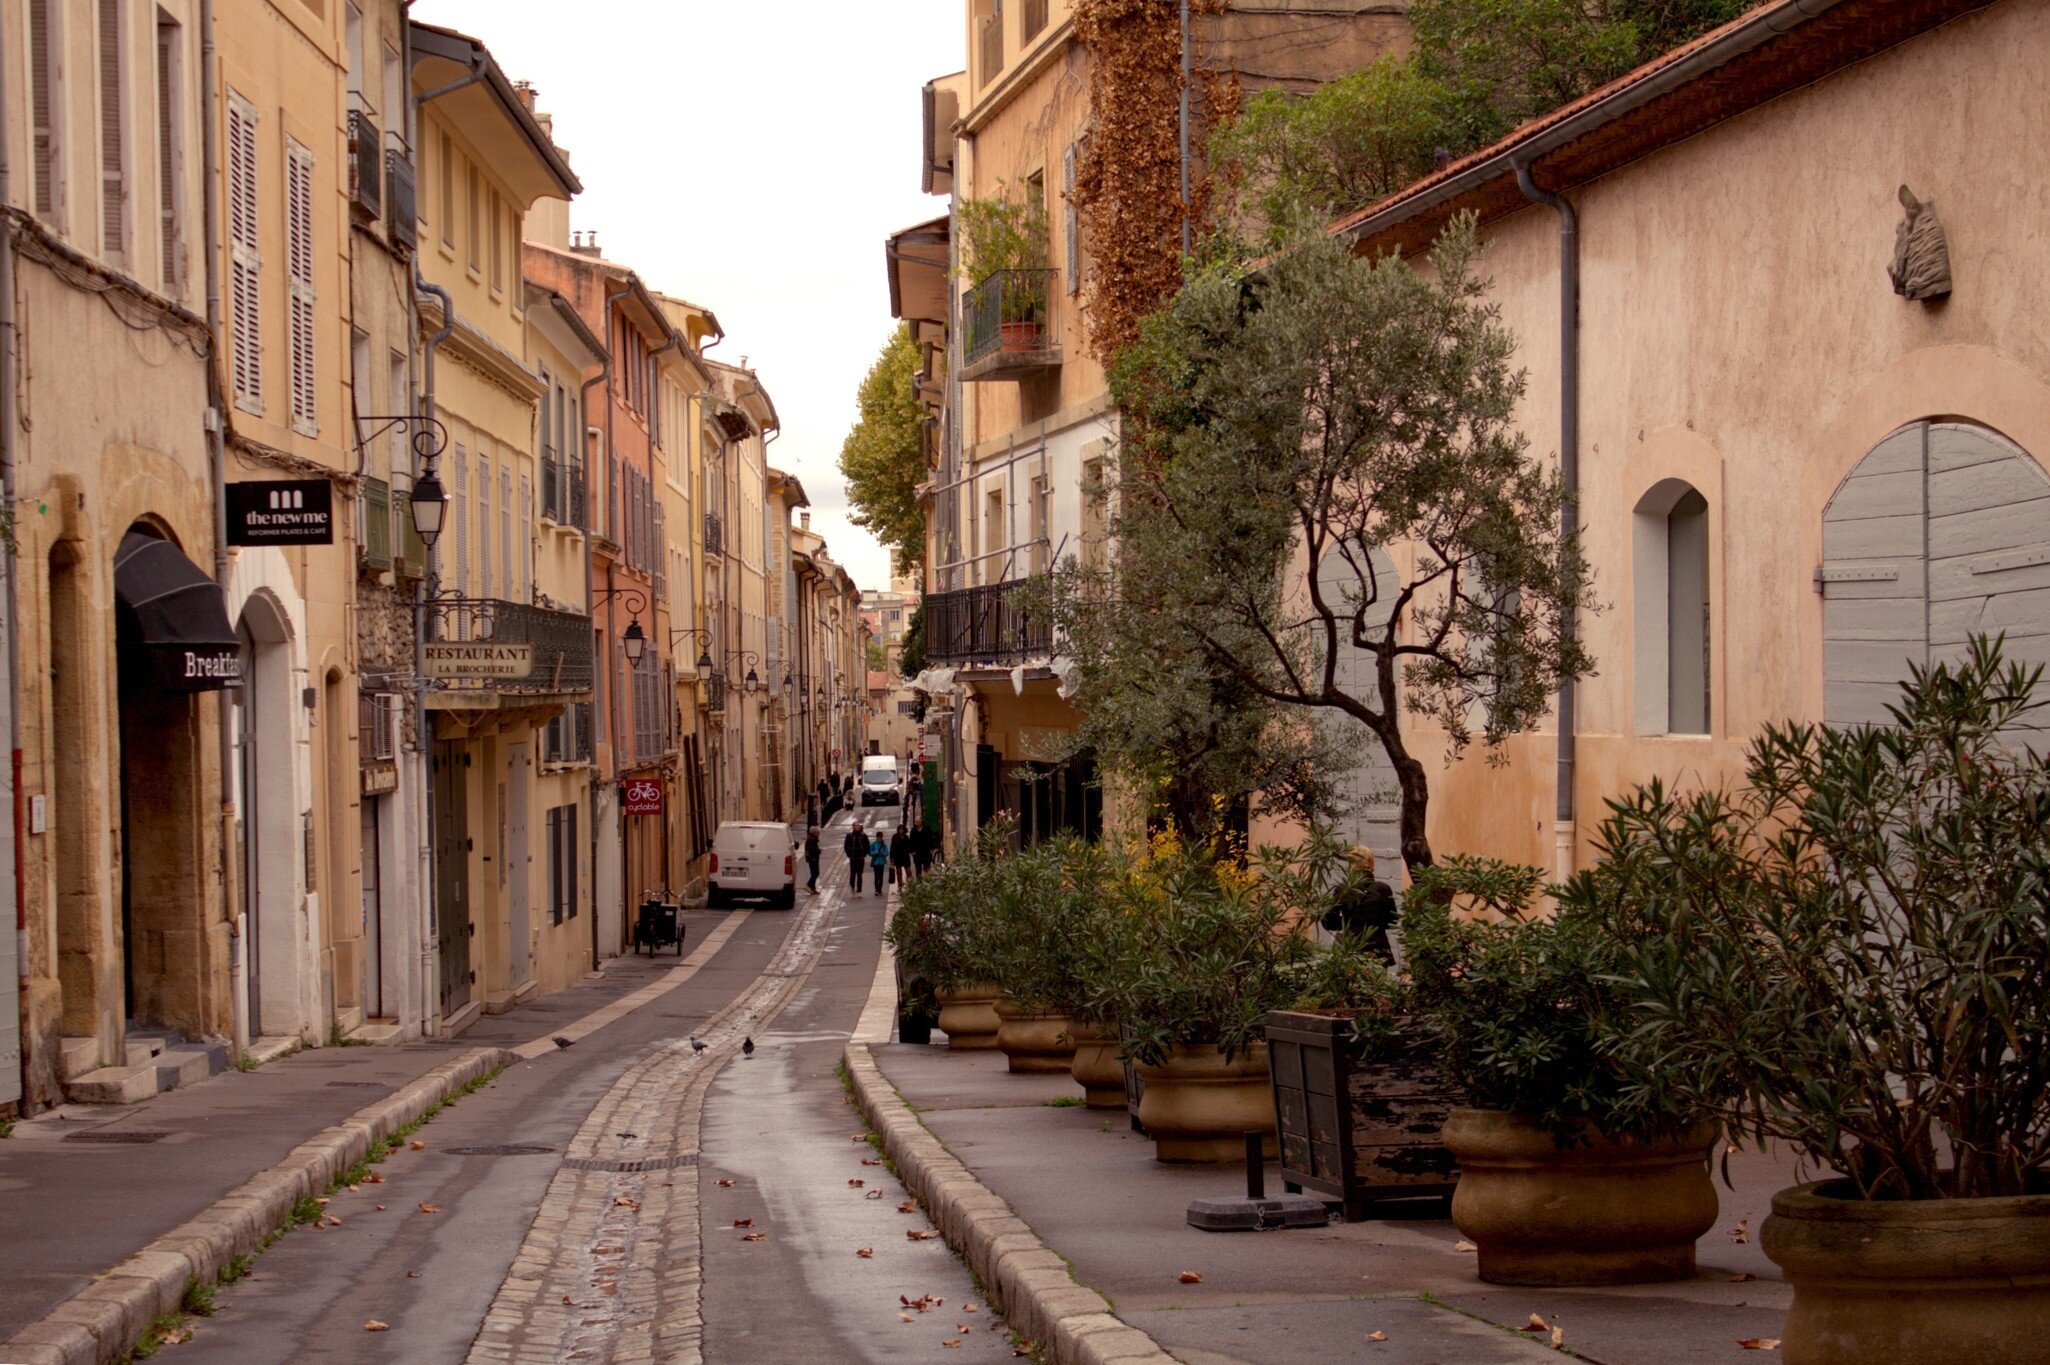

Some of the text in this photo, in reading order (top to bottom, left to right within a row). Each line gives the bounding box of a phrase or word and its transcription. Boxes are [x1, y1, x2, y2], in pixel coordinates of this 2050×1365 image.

[246, 511, 328, 525] the new me
[425, 648, 529, 660] RESTAURANT
[184, 651, 241, 677] Breakfas
[438, 665, 516, 673] LA BROCHERIE
[628, 803, 660, 812] cyclable
